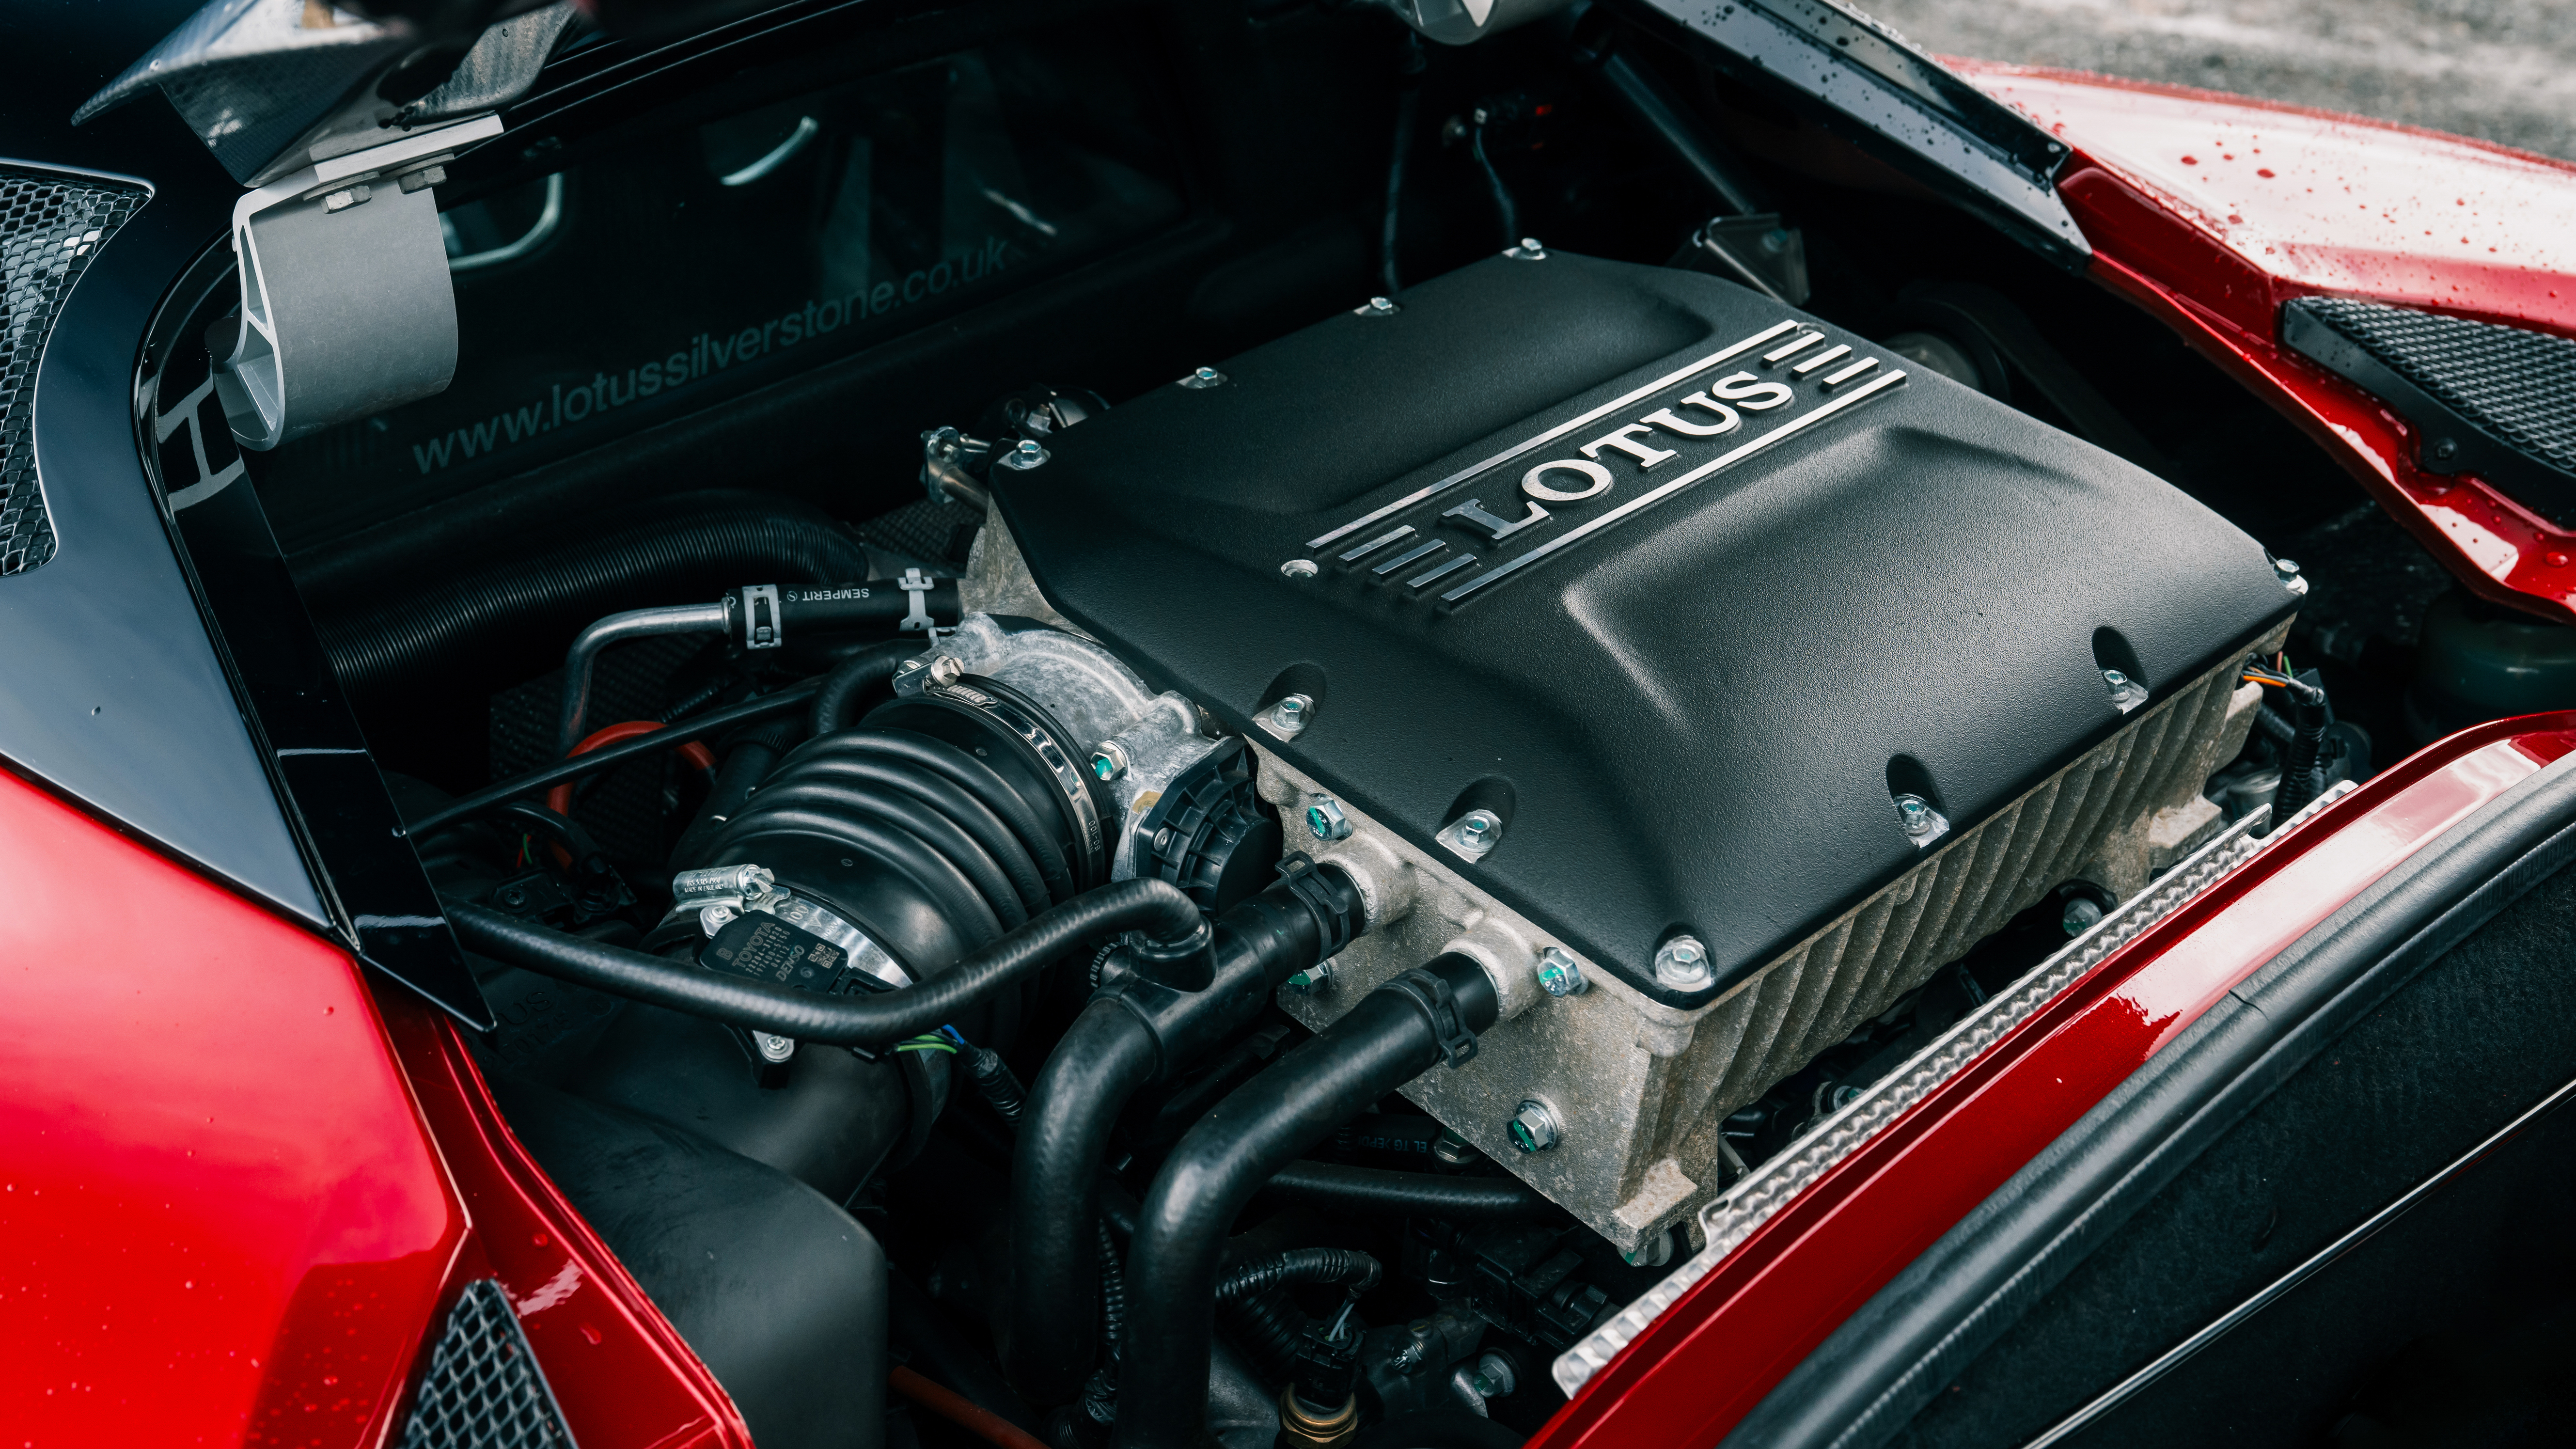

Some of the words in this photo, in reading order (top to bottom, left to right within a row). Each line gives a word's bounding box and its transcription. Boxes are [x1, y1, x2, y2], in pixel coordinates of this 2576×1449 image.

[413, 236, 1008, 474] www.lotussilverstone.co.uk
[1441, 370, 1793, 540] LOTUS
[802, 588, 870, 601] SEMPERIT
[1088, 820, 1100, 851] 80-100
[715, 947, 733, 961] B
[731, 922, 776, 968] TOYOTA
[745, 927, 782, 973] 22204-31020
[775, 945, 805, 982] DENSO
[1358, 1135, 1391, 1150] >EPD
[1394, 1138, 1410, 1151] TG
